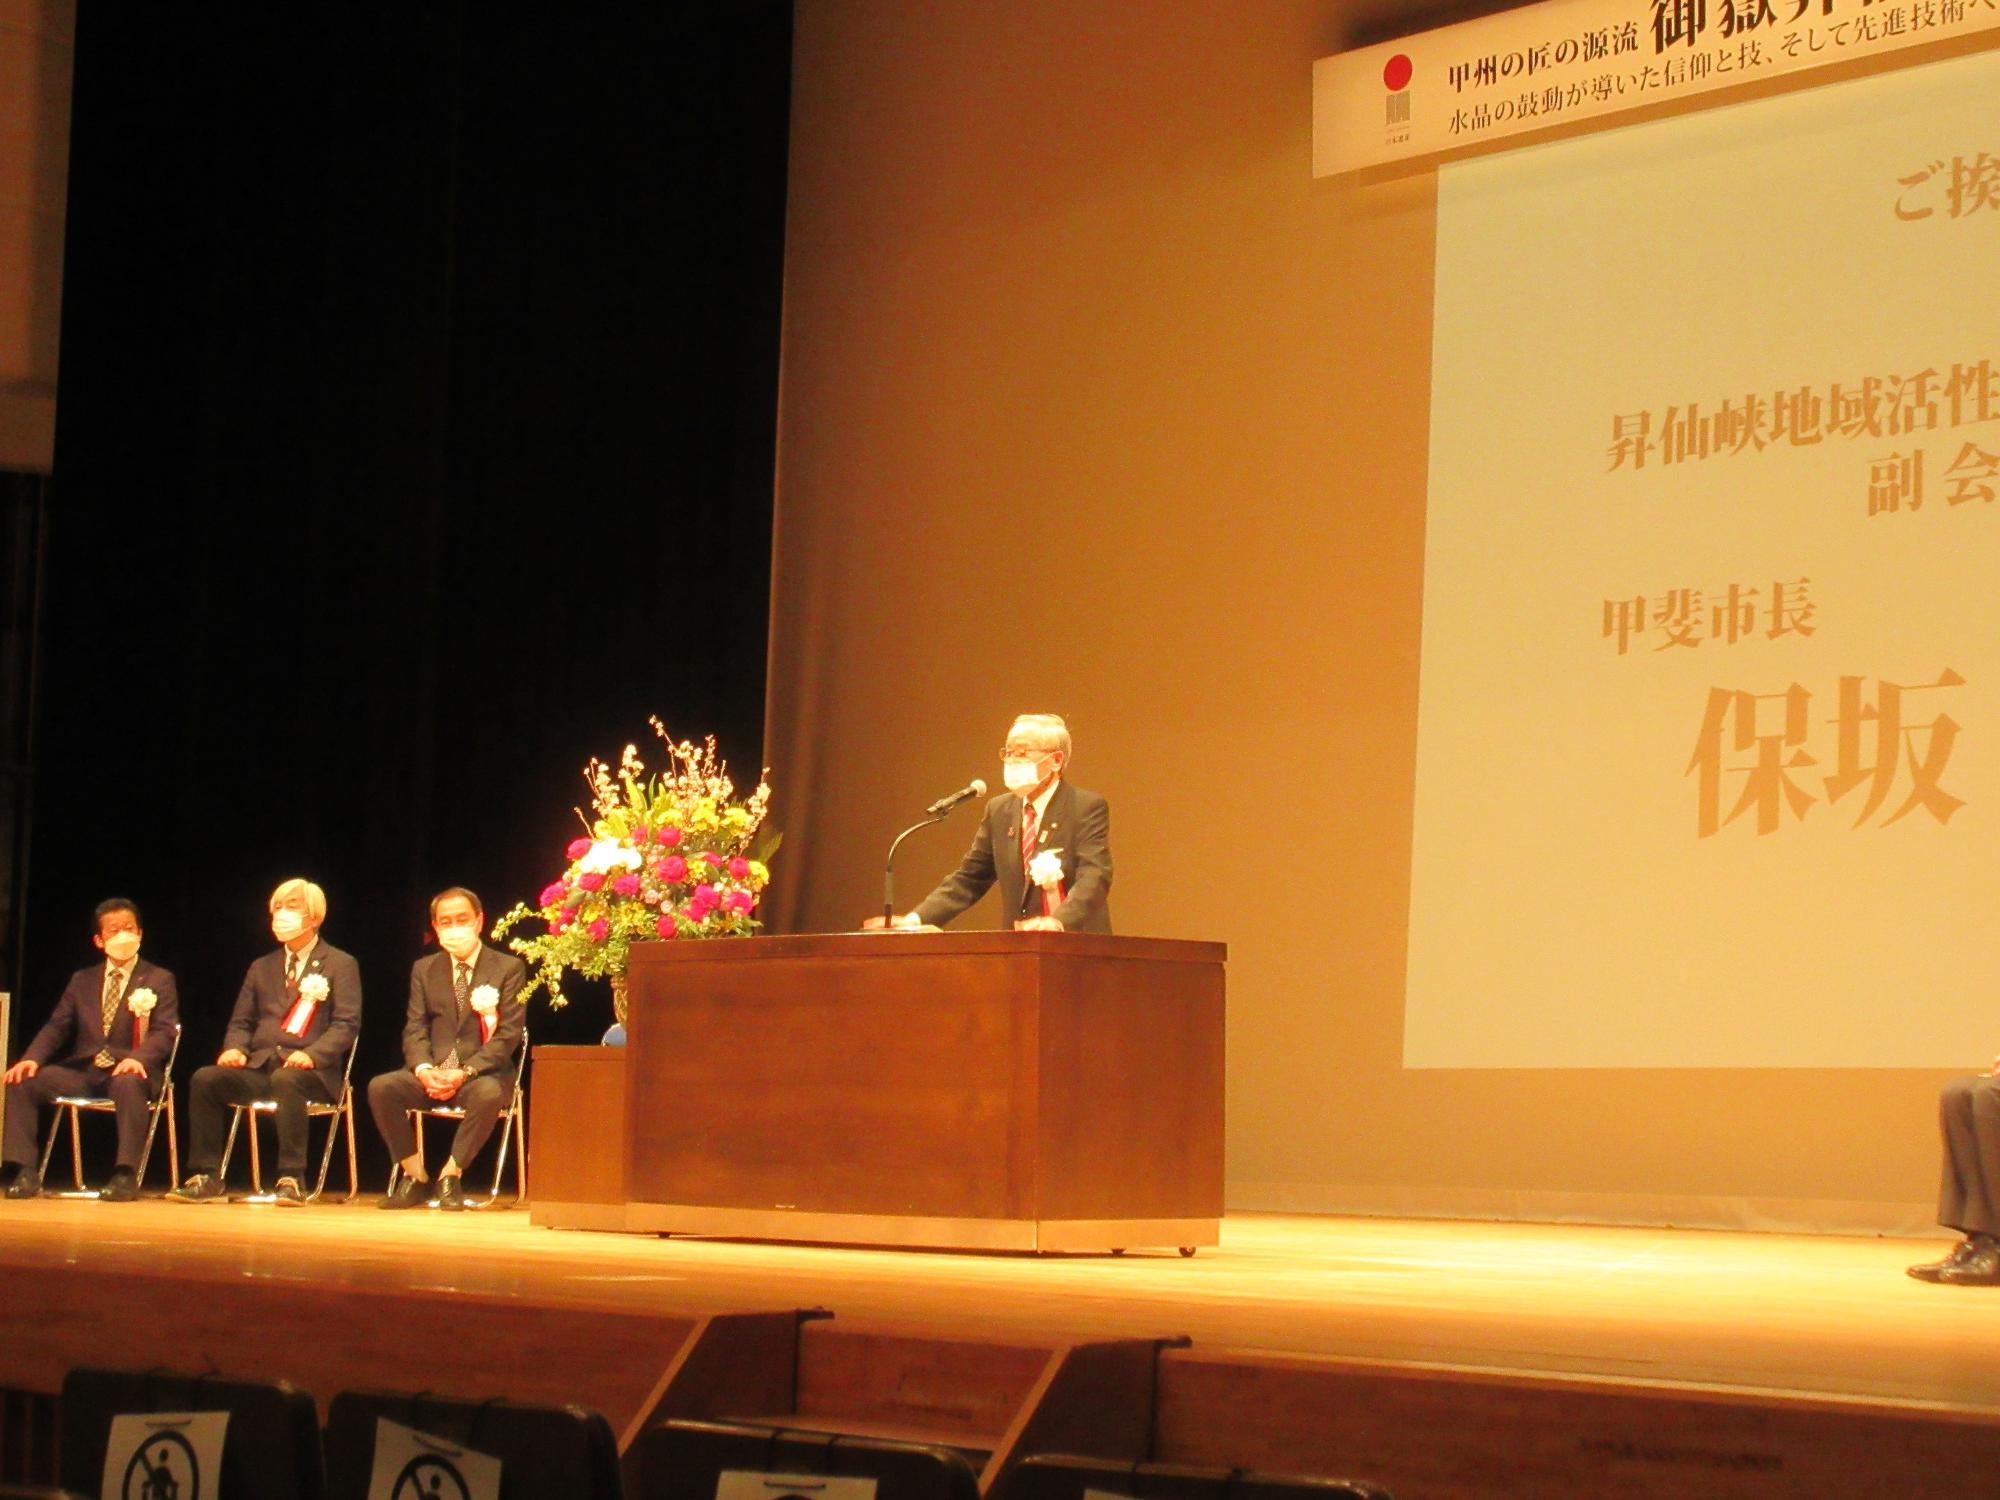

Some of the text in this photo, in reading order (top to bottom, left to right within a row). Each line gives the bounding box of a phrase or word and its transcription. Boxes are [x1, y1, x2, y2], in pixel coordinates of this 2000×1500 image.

[1449, 21, 1639, 93] 甲州の匠の源流
[1606, 359, 2000, 473] 昇仙峡地域活性
[1602, 577, 1818, 656] 甲斐市長
[1684, 666, 1968, 840] 保坂
